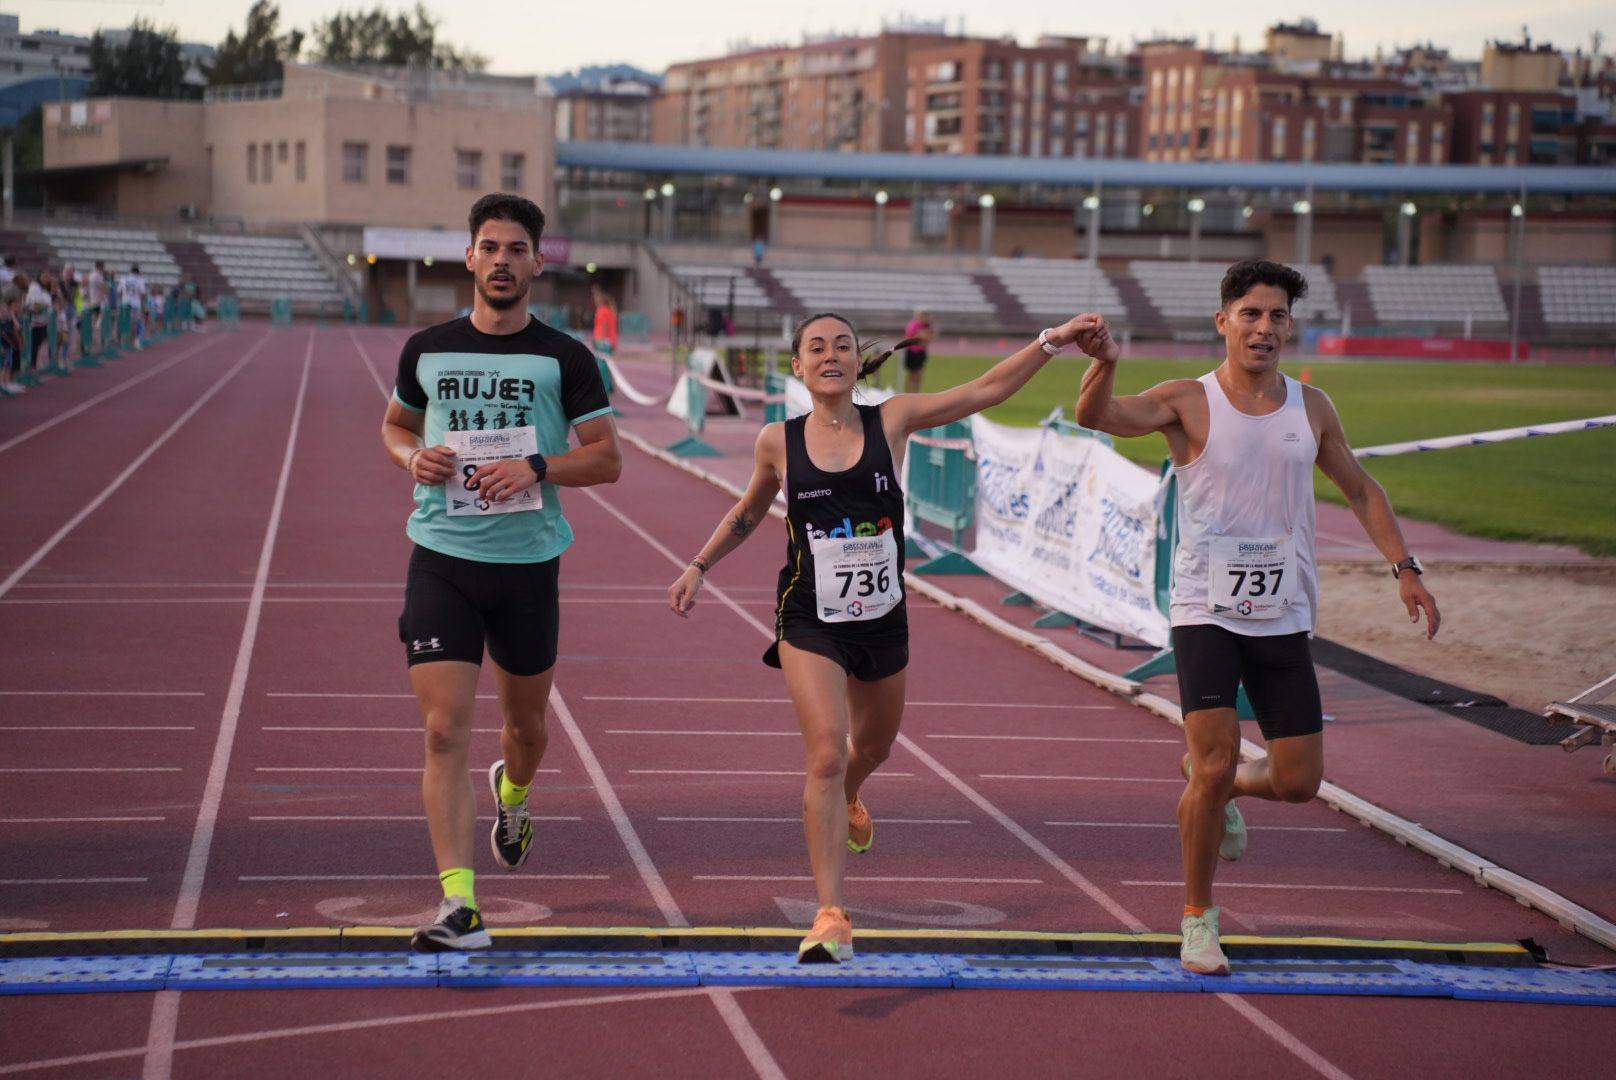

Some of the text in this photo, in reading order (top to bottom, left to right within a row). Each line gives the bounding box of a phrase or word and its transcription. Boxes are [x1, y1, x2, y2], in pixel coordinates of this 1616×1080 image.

[438, 377, 535, 402] MUJER
[835, 566, 890, 599] 736
[1228, 569, 1284, 597] 737
